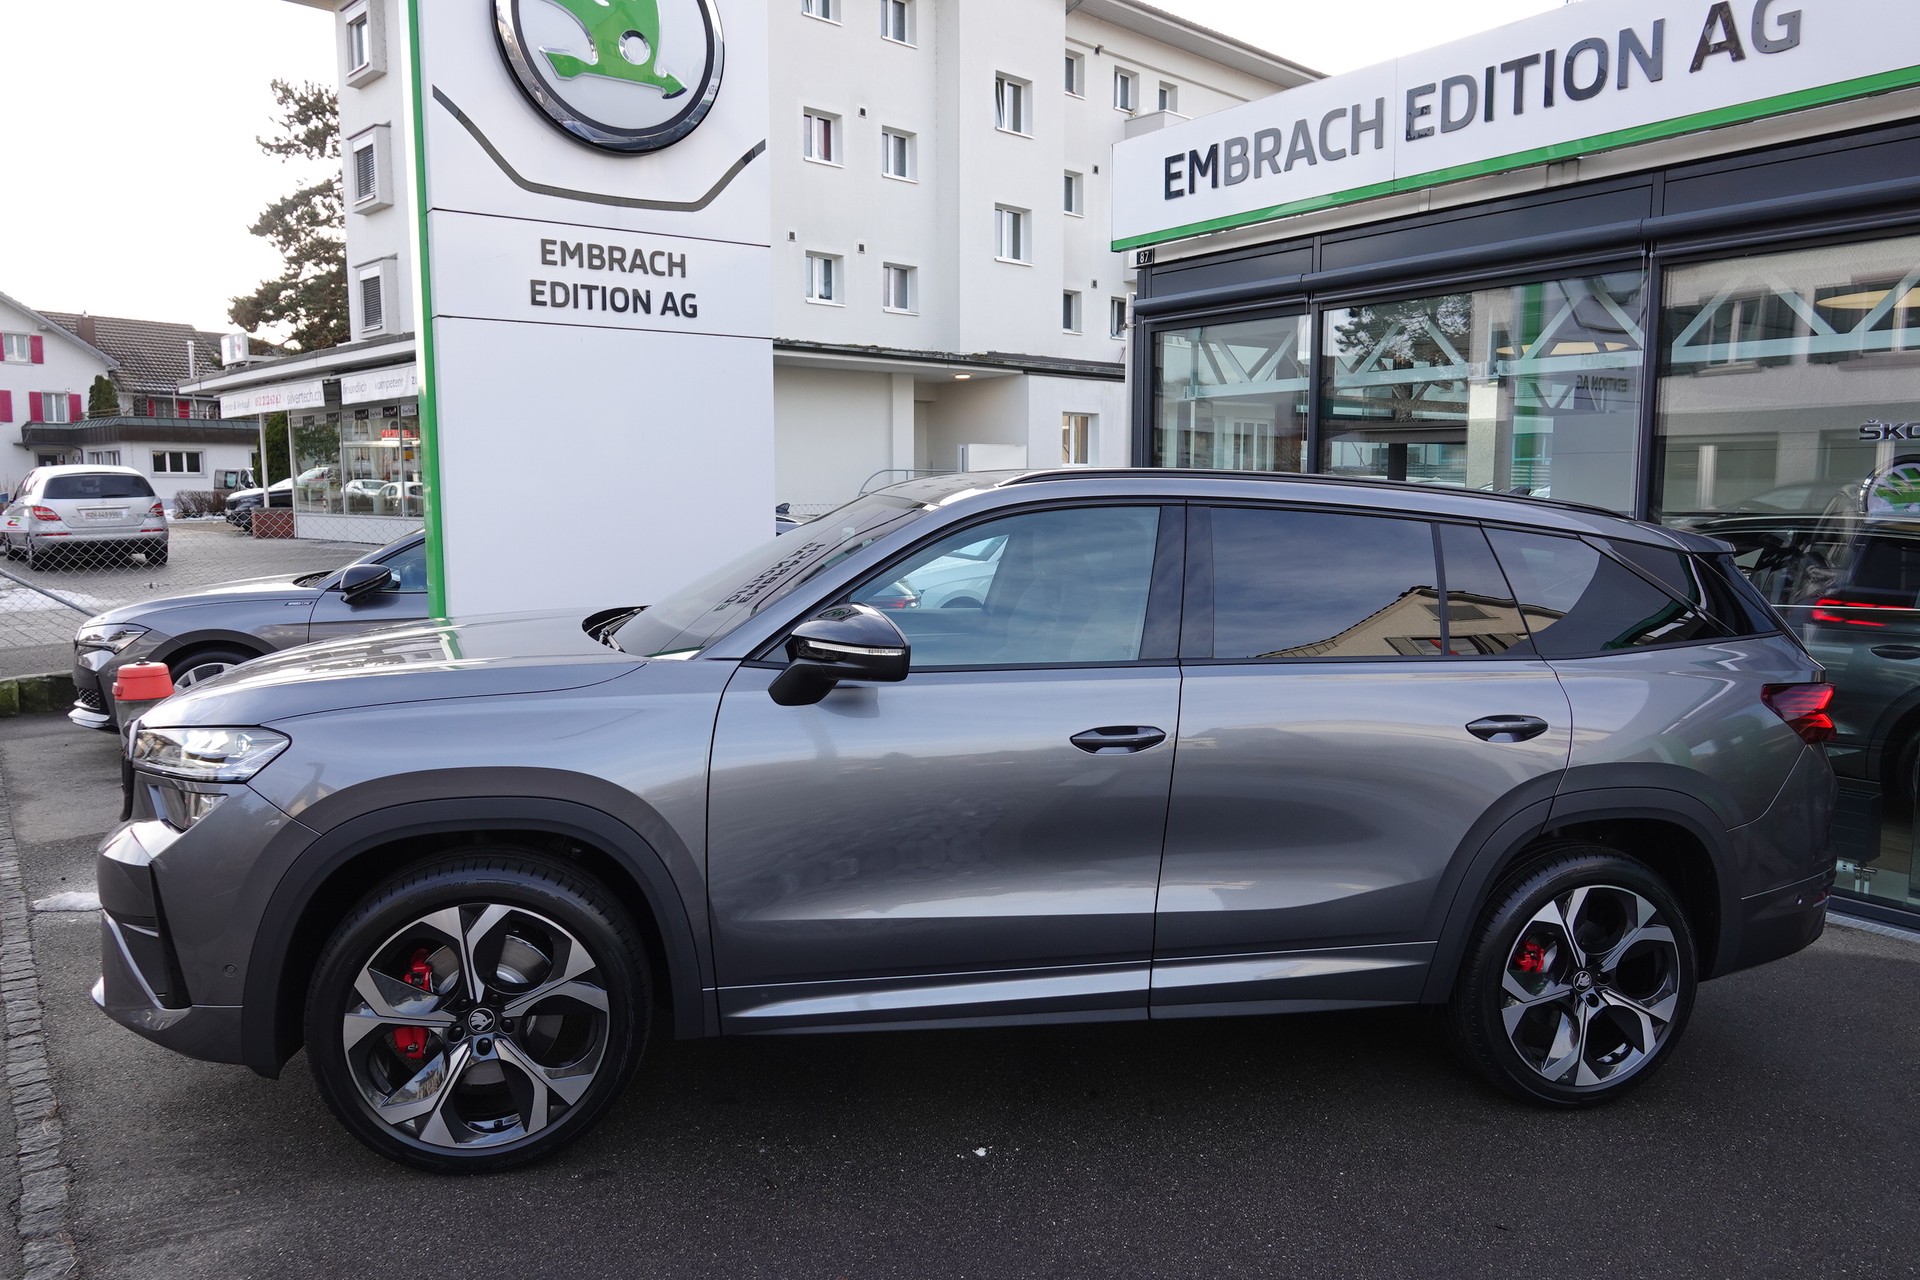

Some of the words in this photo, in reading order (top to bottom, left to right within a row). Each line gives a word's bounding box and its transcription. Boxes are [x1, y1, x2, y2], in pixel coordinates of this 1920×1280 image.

[1165, 97, 1385, 200] EMBRACH
[1406, 18, 1666, 142] EDITION
[1689, 0, 1802, 73] AG
[540, 238, 686, 278] EMBRACH
[1139, 250, 1149, 263] 87
[530, 279, 651, 314] EDITION
[660, 291, 698, 318] AG
